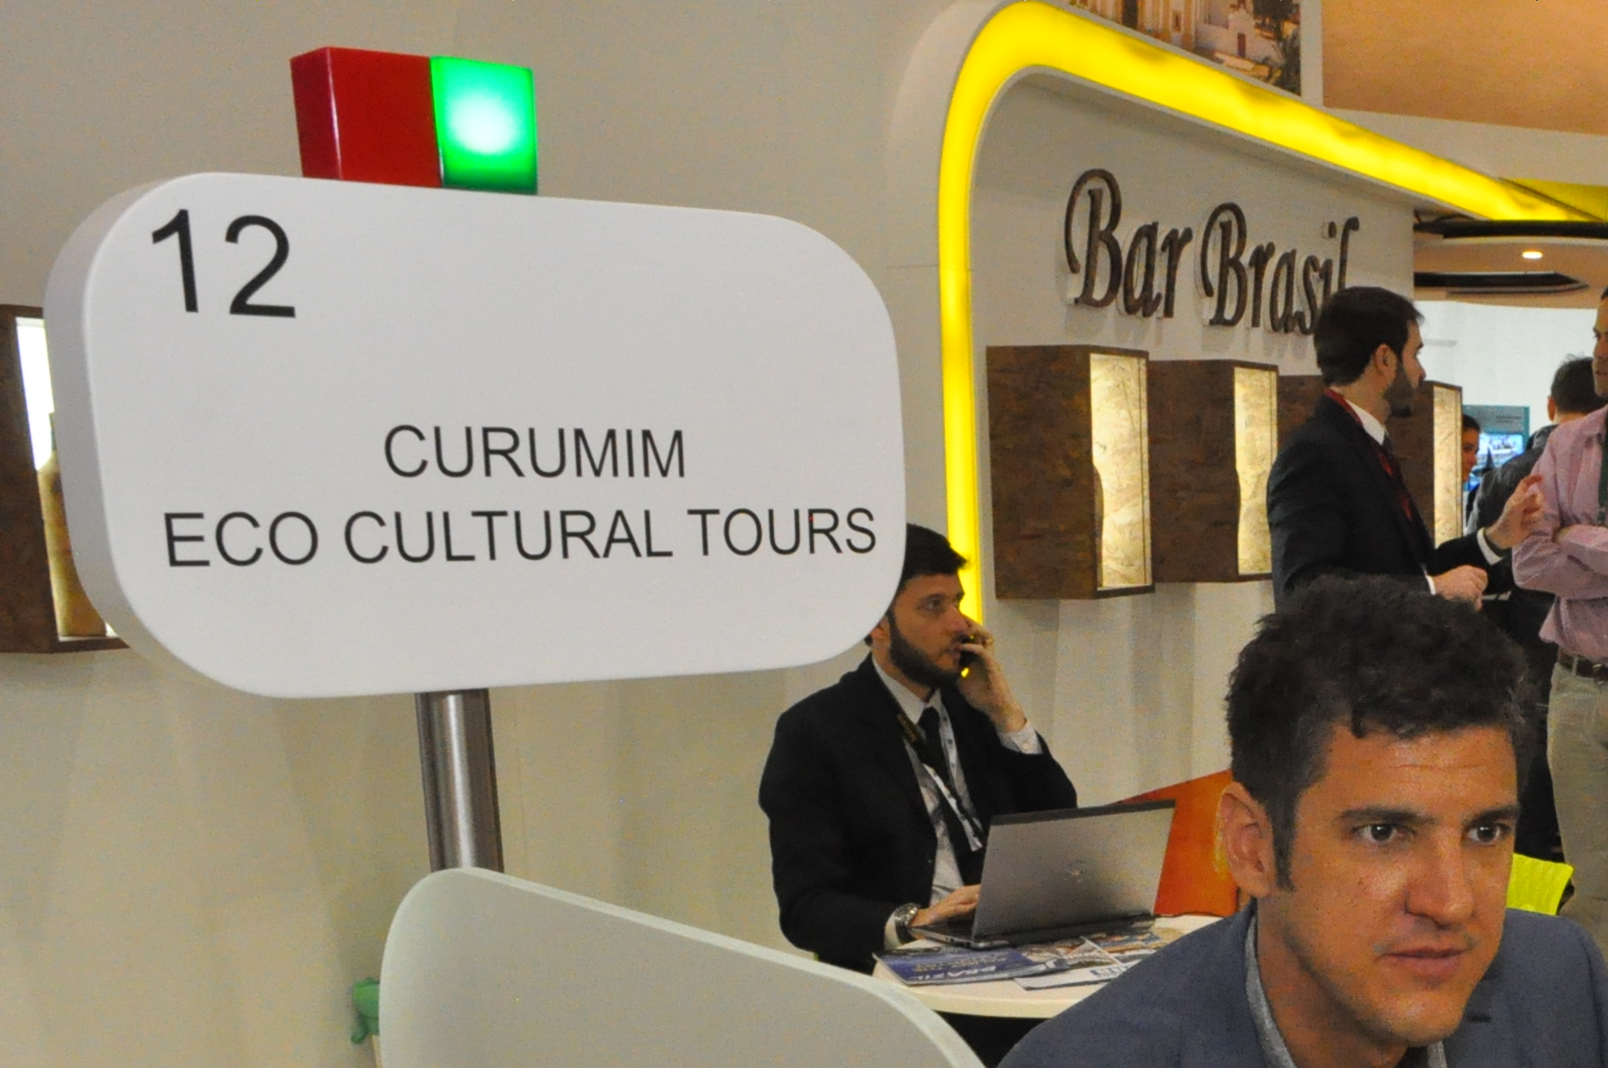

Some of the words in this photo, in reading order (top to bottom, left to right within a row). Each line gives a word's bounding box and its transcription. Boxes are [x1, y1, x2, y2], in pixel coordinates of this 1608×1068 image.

[152, 209, 296, 318] 12
[1064, 168, 1193, 319] Bar
[1200, 202, 1360, 335] Brasil
[384, 424, 685, 478] CURUMIM
[164, 511, 318, 567] ECO
[344, 510, 673, 564] CULTURAL
[687, 507, 876, 556] TOURS
